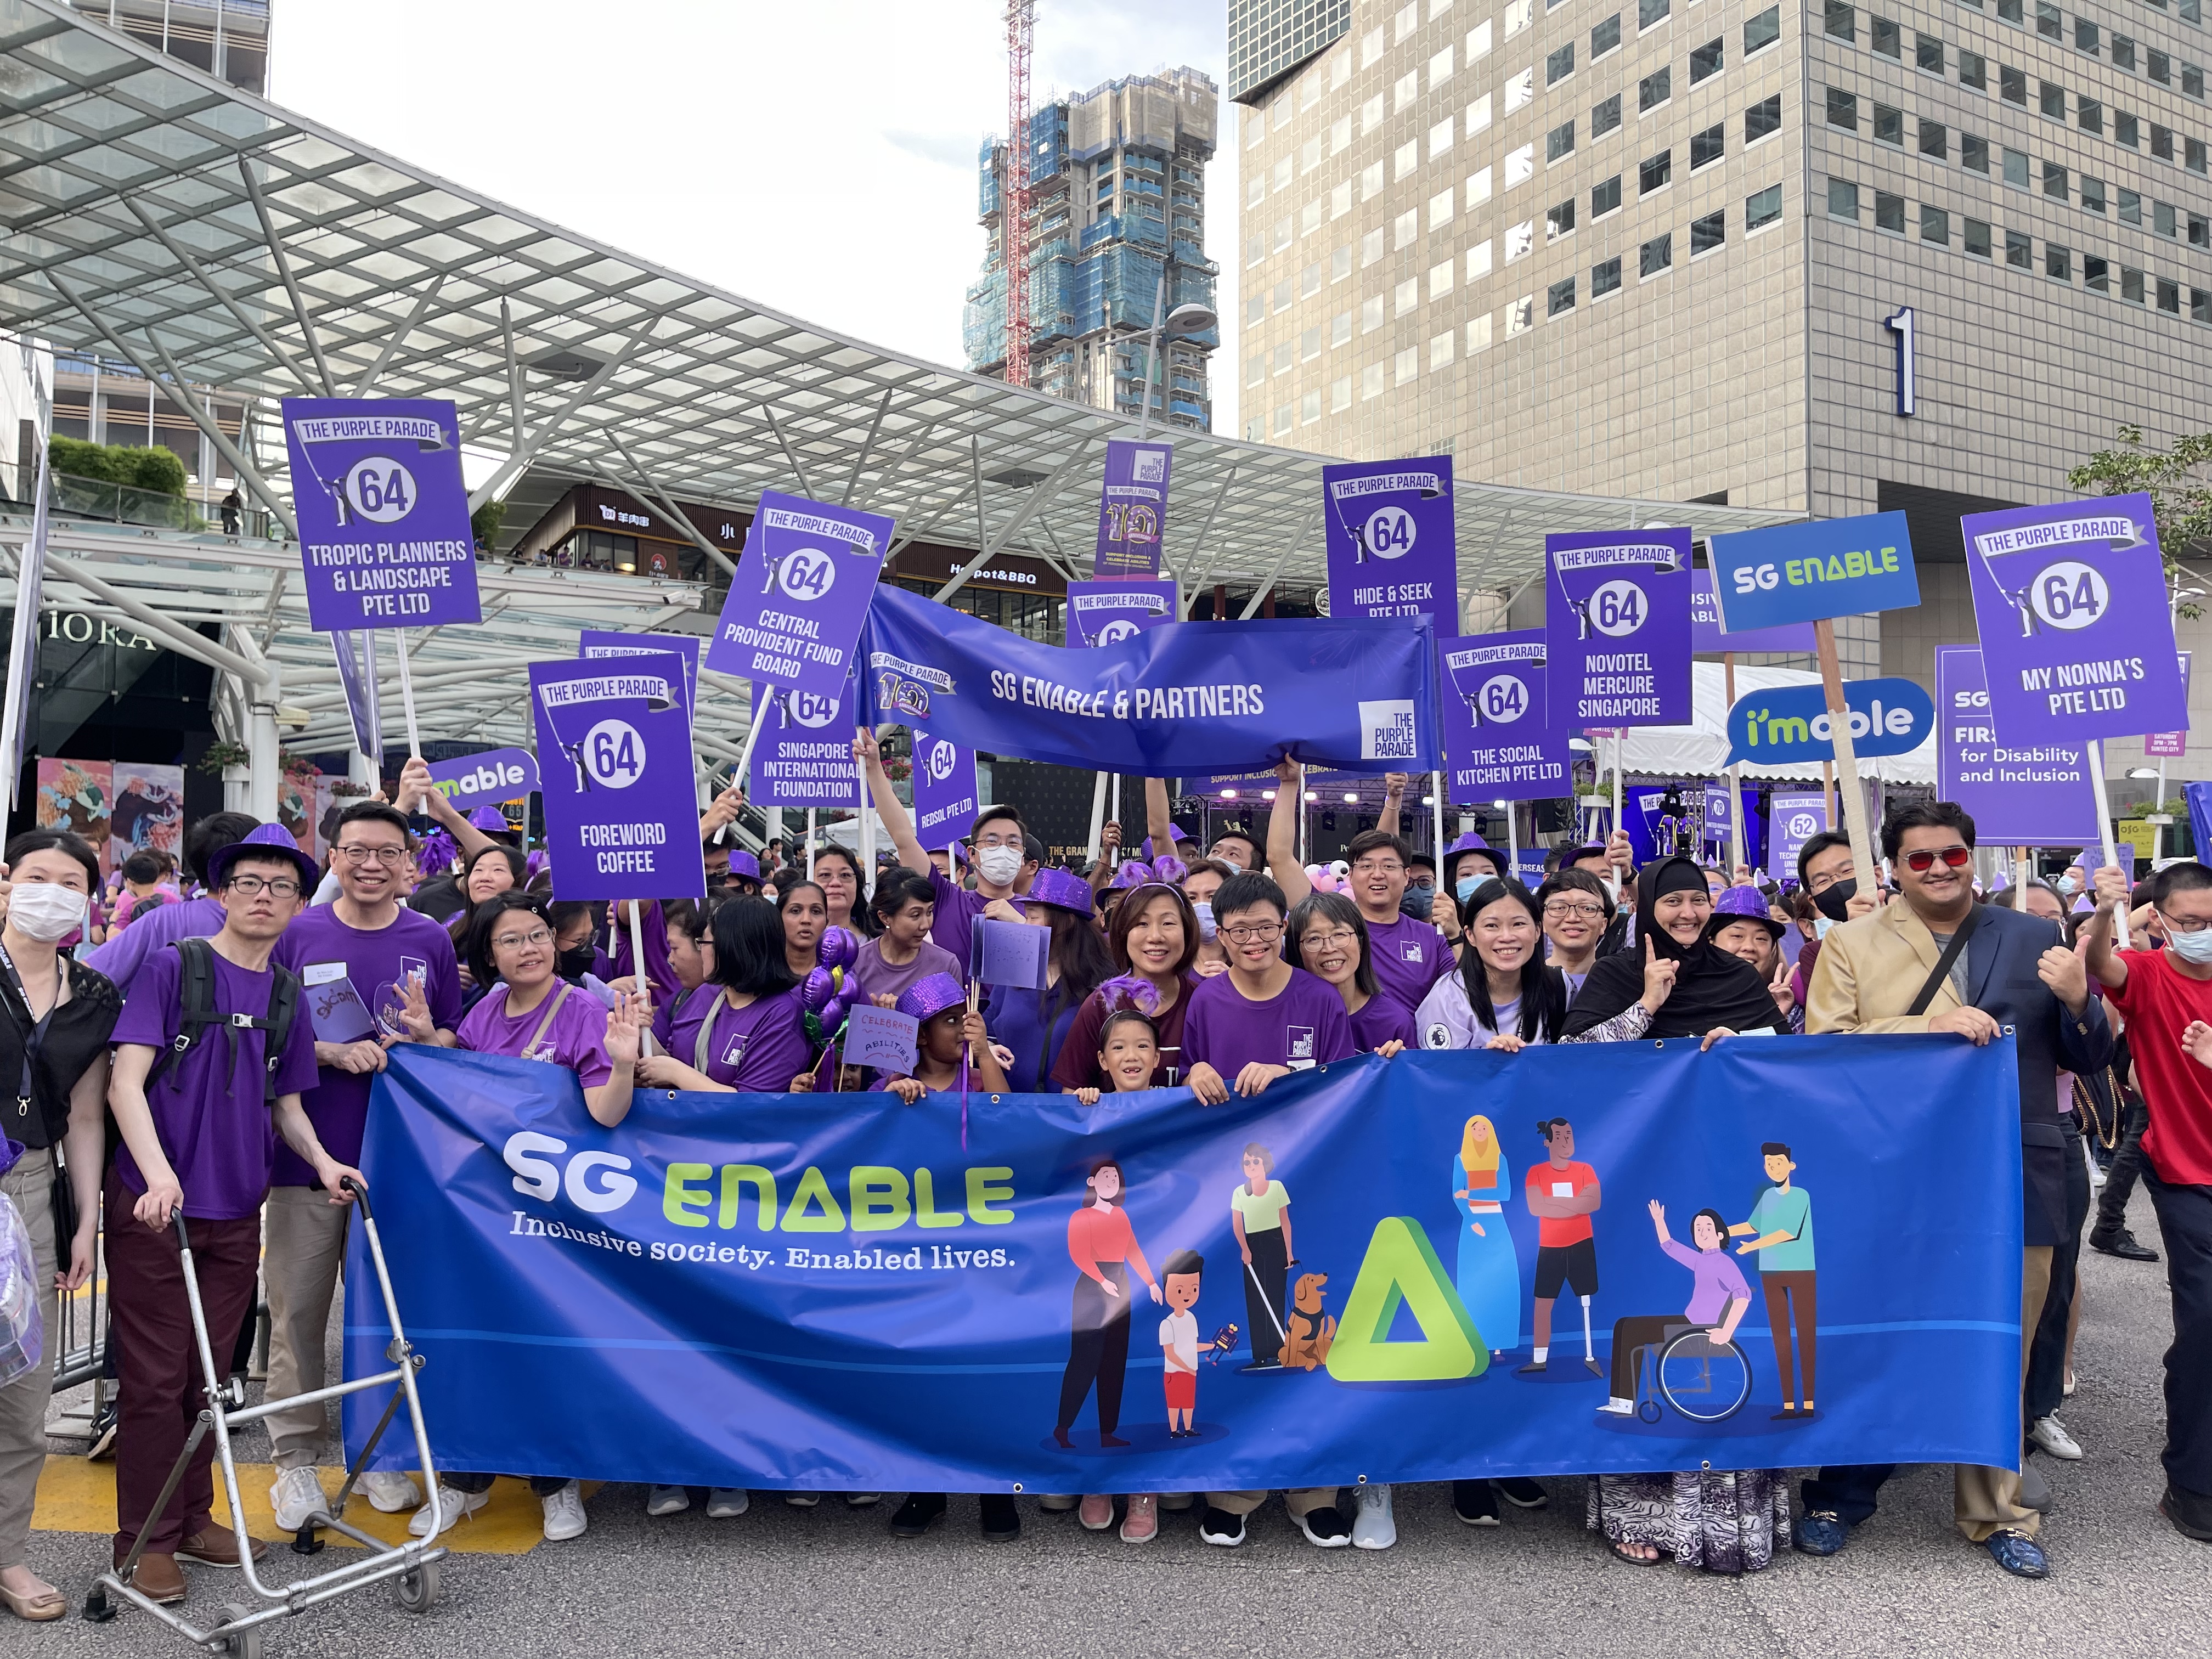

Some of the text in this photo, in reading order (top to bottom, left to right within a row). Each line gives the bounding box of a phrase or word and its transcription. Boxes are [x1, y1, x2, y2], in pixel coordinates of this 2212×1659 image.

[1885, 306, 1914, 417] 1
[303, 420, 436, 438] THE PURPLE PARADE
[1141, 465, 1163, 474] PURPLE
[1153, 458, 1163, 466] THE
[1140, 472, 1161, 481] PARADE
[1336, 475, 1435, 496] THE PURPLE PARADE
[358, 469, 408, 512] 64
[1138, 489, 1158, 498] PARADE
[770, 511, 872, 546] THE PURPLE PARADE
[1373, 515, 1409, 552] 64
[1984, 520, 2129, 553] THE PURPLE PARADE
[308, 540, 467, 567] TROPIC PLANNERS
[1560, 548, 1672, 567] THE PURPLE PARADE
[334, 567, 452, 592] & LANDSCAPE
[786, 555, 829, 596] 64
[1733, 546, 1900, 594] SG ENABLE
[363, 592, 430, 617] PTE LTD
[1079, 595, 1162, 608] THE PURPLE PARADE
[1353, 582, 1434, 605] HIDE & SEEK
[2043, 572, 2100, 619] 64
[1599, 589, 1640, 628] 64
[759, 610, 821, 639] CENTRAL
[724, 623, 843, 667] PROVIDENT FUND
[1452, 646, 1545, 667] THE PURPLE PARADE
[752, 651, 802, 679] BOARD
[884, 655, 915, 675] PURPLE
[916, 668, 949, 685] PARADE
[1585, 653, 1652, 673] NOVOTEL
[2022, 657, 2145, 692] MY NONNA'S
[546, 679, 664, 703] THE PURPLE PARADE
[990, 670, 1264, 719] SG ENABLE & PARTNERS
[1583, 675, 1655, 695] MERCURE
[798, 691, 832, 720] 64
[1487, 682, 1522, 715] 64
[1578, 697, 1661, 718] SINGAPORE
[1955, 691, 1989, 708] SG
[2049, 687, 2126, 715] PTE LTD
[1393, 713, 1413, 727] THE
[1374, 727, 1414, 743] PURPLE
[1955, 727, 1995, 743] FIR
[592, 731, 639, 779] 64
[778, 742, 849, 759] SINGAPORE
[935, 743, 952, 775] 64
[1374, 741, 1415, 757] PARADE
[1472, 745, 1544, 766] THE SOCIAL
[1960, 747, 2079, 765] for Disability
[764, 761, 861, 779] INTERNATIONAL
[1457, 763, 1562, 786] KITCHEN PTE LTD
[1960, 767, 2080, 782] and Inclusion
[774, 781, 853, 798] FOUNDATION
[921, 797, 972, 830] REDSOL PTE LTD
[1643, 798, 1655, 808] THE
[1716, 802, 1723, 814] 78
[580, 822, 666, 848] FOREWORD
[1794, 818, 1813, 835] 52
[596, 850, 656, 874] COFFEE
[1048, 846, 1064, 856] THE
[1066, 846, 1088, 856] GRAN
[862, 1014, 913, 1034] CELEBRATE
[866, 1040, 910, 1063] ABILITIES
[1293, 1040, 1312, 1049] PURPLE
[1293, 1048, 1311, 1056] PARADE
[503, 1131, 1015, 1233] SG ENABLE
[509, 1210, 1016, 1271] Inclusive society. Enabled lives.
